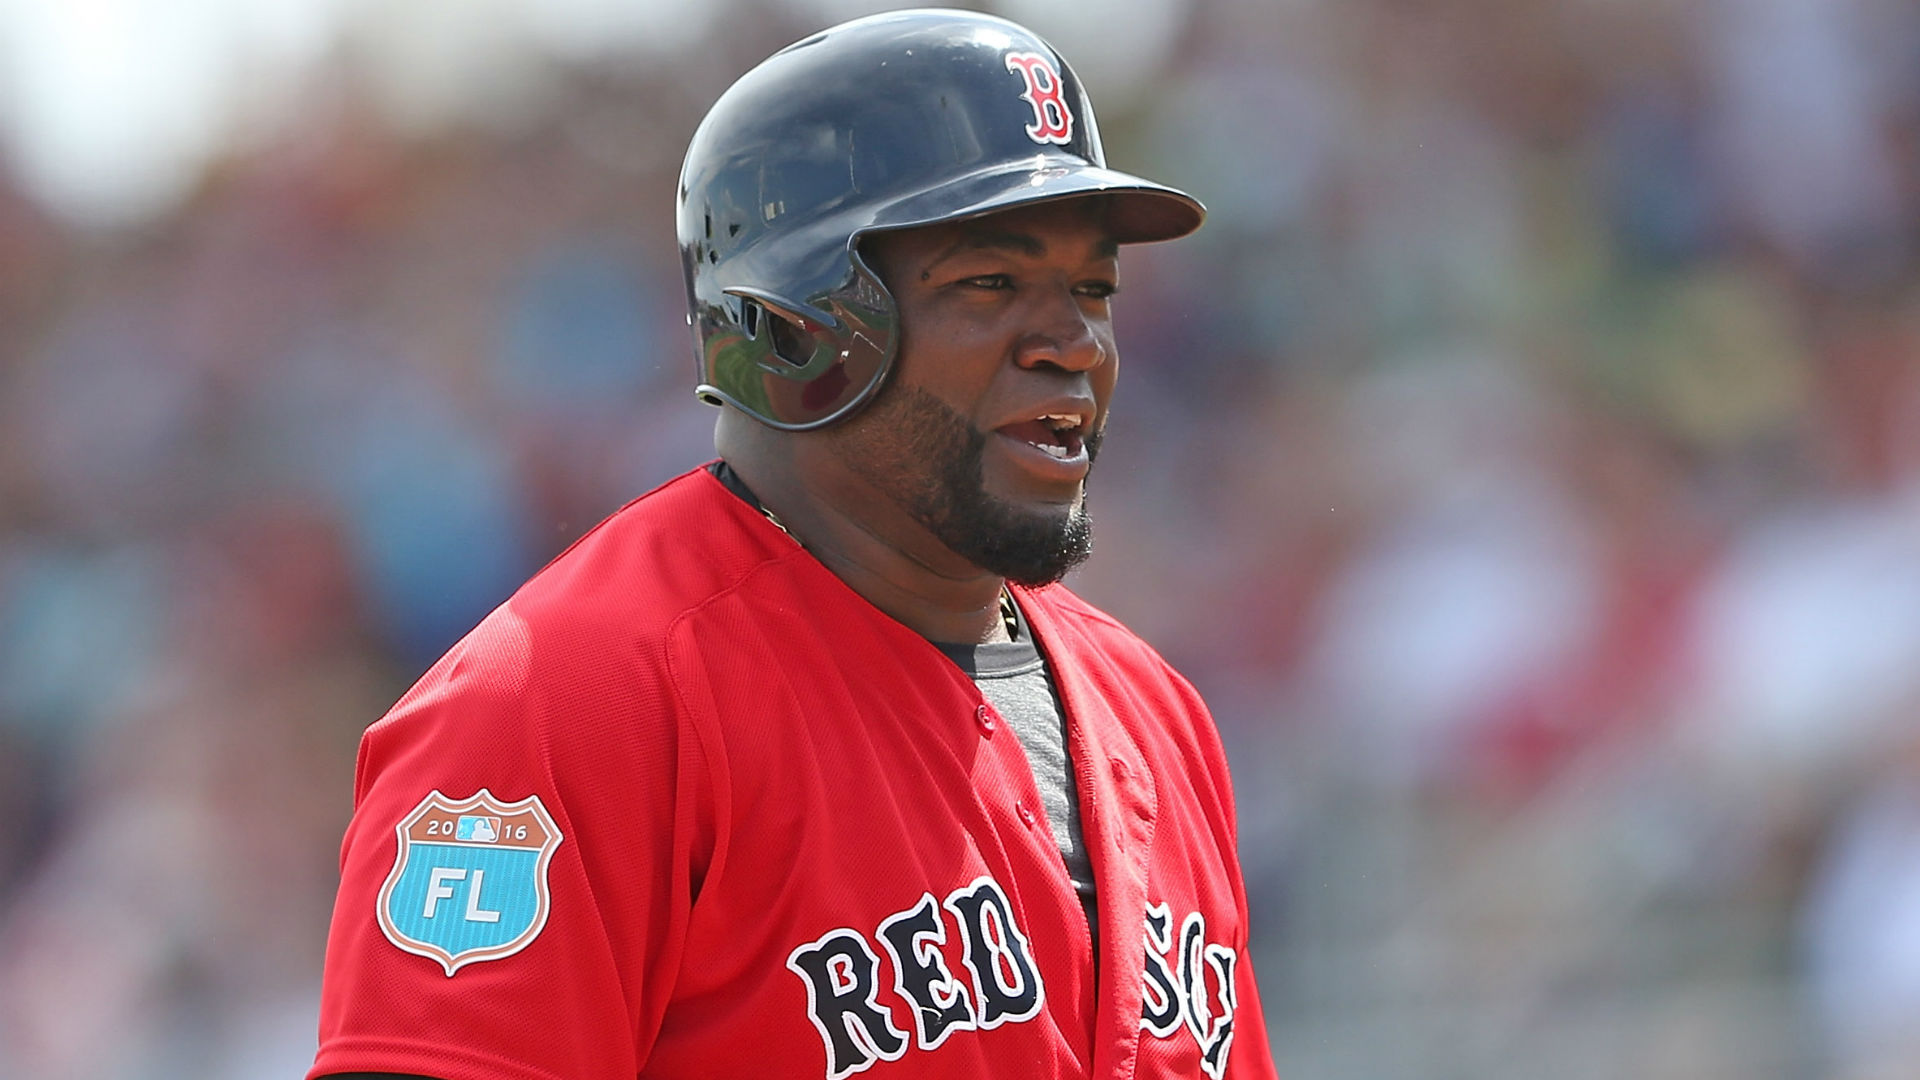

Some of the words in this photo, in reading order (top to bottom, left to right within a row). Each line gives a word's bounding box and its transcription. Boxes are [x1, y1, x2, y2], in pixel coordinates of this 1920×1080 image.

[1005, 51, 1074, 145] B
[426, 820, 454, 836] 20
[505, 824, 527, 840] 16
[423, 867, 500, 923] FL
[786, 876, 1045, 1080] RED
